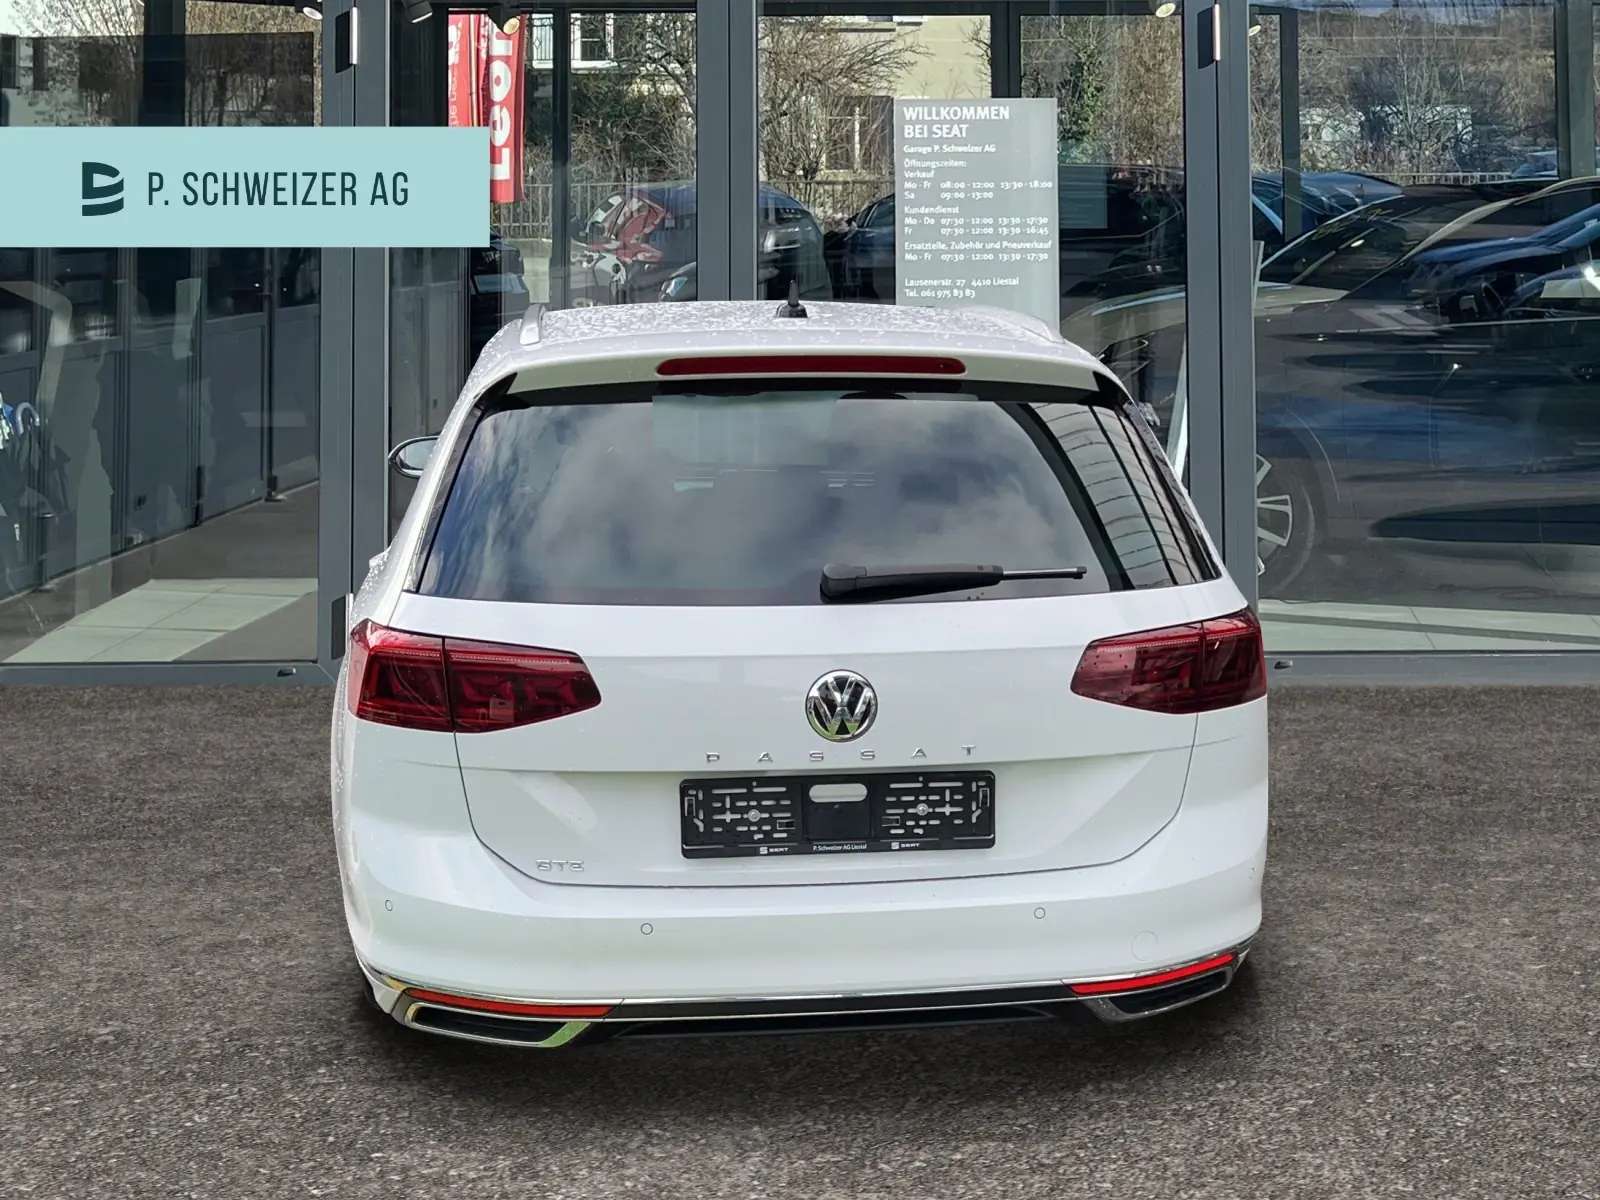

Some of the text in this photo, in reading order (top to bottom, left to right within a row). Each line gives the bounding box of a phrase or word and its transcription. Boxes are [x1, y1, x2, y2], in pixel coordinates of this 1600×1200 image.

[903, 106, 1010, 120] WILLKOMMEN
[903, 124, 969, 138] BEI SEAT
[903, 145, 996, 153] Garage P. Schweizer AG
[904, 158, 967, 169] Öffnungszeiten:
[904, 170, 935, 178] Verkauf
[904, 181, 917, 189] Mo
[923, 181, 931, 189] Fr
[940, 181, 965, 189] 08:00
[972, 181, 995, 189] 12:00
[1000, 181, 1023, 189] 13:30
[904, 192, 914, 200] Sa
[940, 192, 965, 200] 09:00
[972, 192, 994, 200] 13:00
[904, 206, 959, 214] Kundendienst
[904, 217, 917, 225] Mo
[924, 217, 935, 225] Do
[940, 217, 964, 225] 07:30
[972, 217, 994, 225] 12:00
[904, 227, 913, 235] Fr
[940, 227, 964, 235] 07:30
[972, 227, 994, 235] 12:00
[950, 241, 983, 250] Zubehör
[985, 241, 1000, 250] und
[1002, 241, 1052, 250] Pneuverkauf
[904, 253, 917, 261] Mo
[924, 253, 932, 261] Fr
[941, 253, 964, 261] 07:30
[972, 253, 994, 261] 12:00
[956, 278, 966, 286] 27
[993, 278, 1019, 286] Liestal
[905, 289, 976, 298] Tel. 061 975 83 83
[705, 744, 976, 763] PASSAT
[536, 859, 584, 873] GTE
